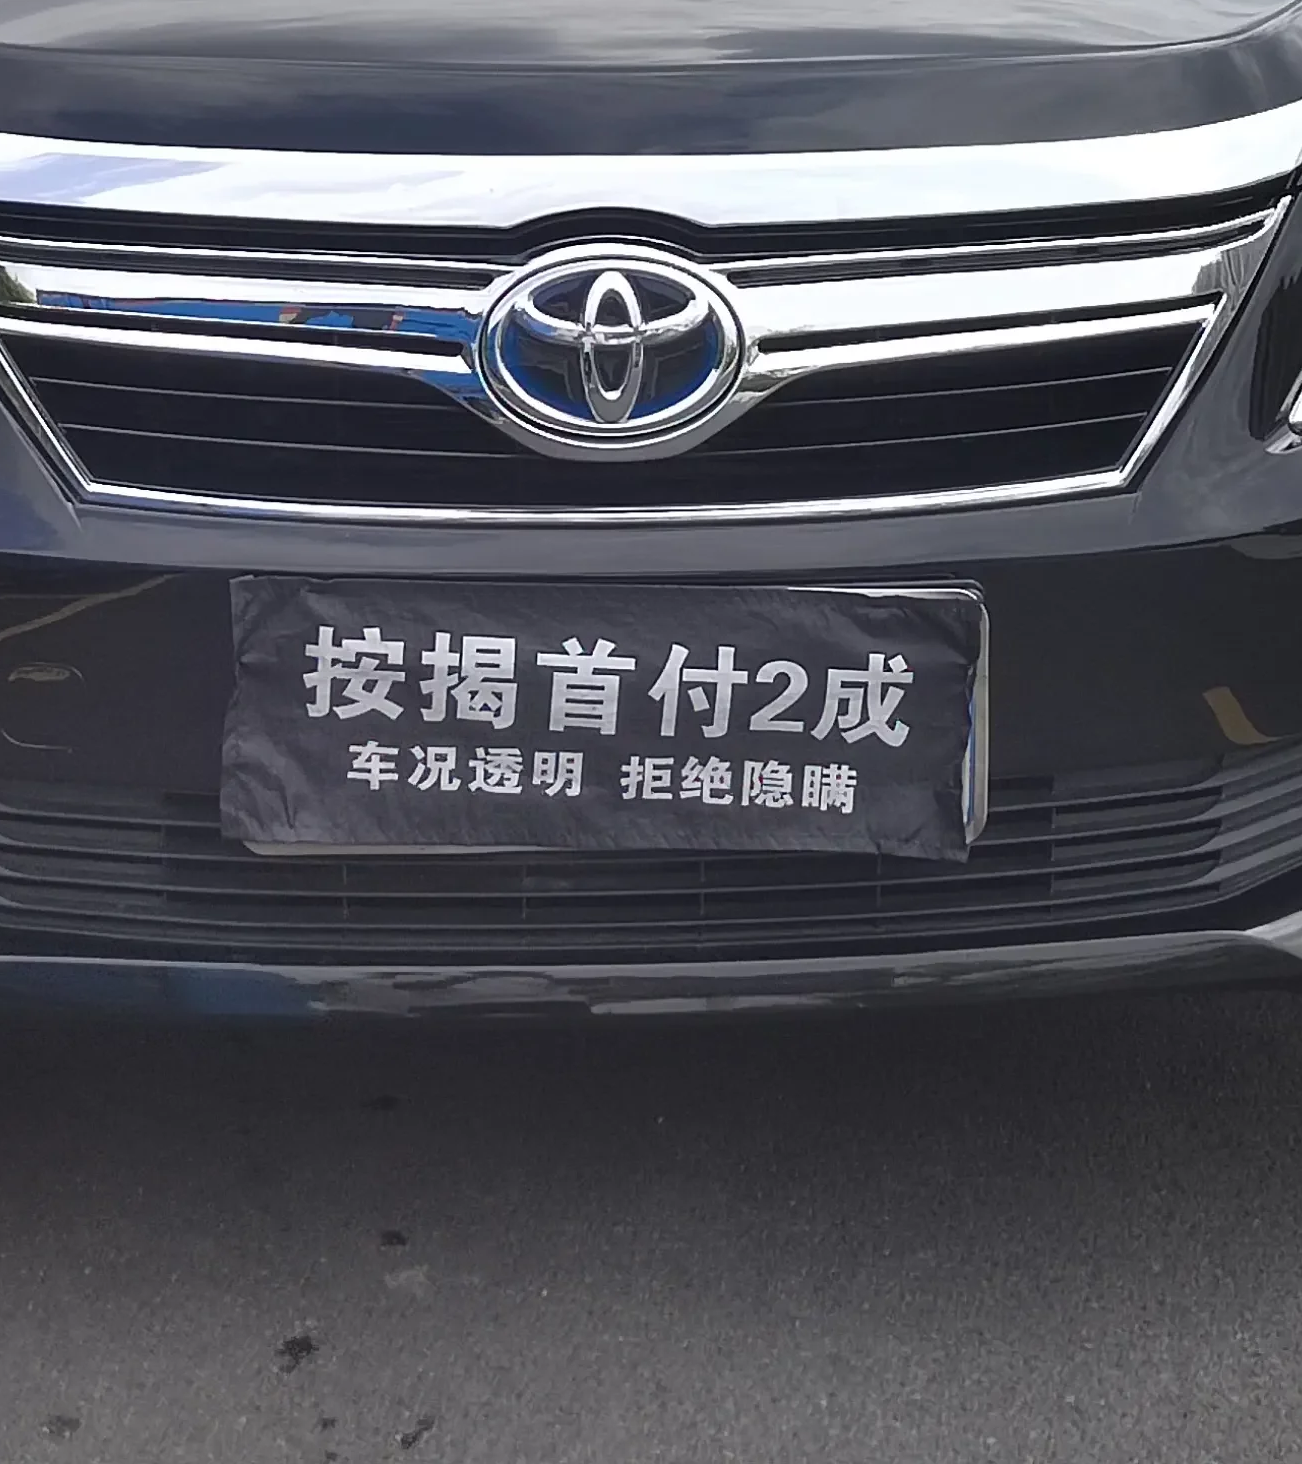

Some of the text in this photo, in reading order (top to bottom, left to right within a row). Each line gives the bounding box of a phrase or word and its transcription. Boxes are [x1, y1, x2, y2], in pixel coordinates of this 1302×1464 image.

[302, 625, 914, 747] 按揭首付2成
[346, 740, 858, 814] 车况透明 拒绝隐瞒
